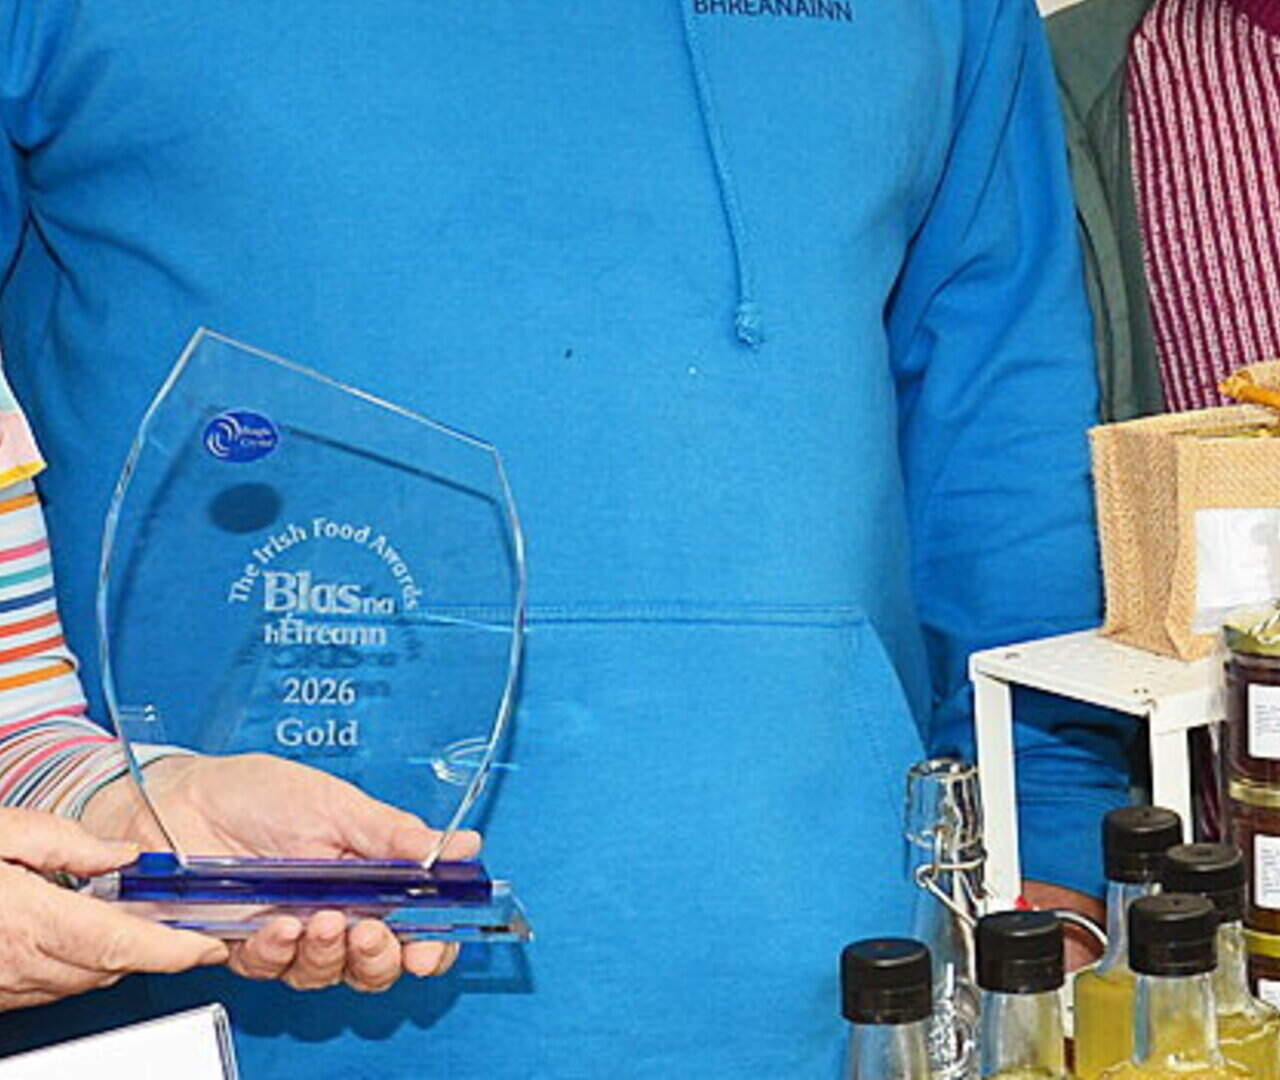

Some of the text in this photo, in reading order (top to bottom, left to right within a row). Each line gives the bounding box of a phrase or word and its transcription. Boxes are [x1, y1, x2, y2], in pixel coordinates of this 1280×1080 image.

[228, 517, 422, 610] The Irish Food Awards
[262, 570, 395, 614] Blas na
[282, 677, 356, 706] 2026
[276, 717, 359, 747] Gold
